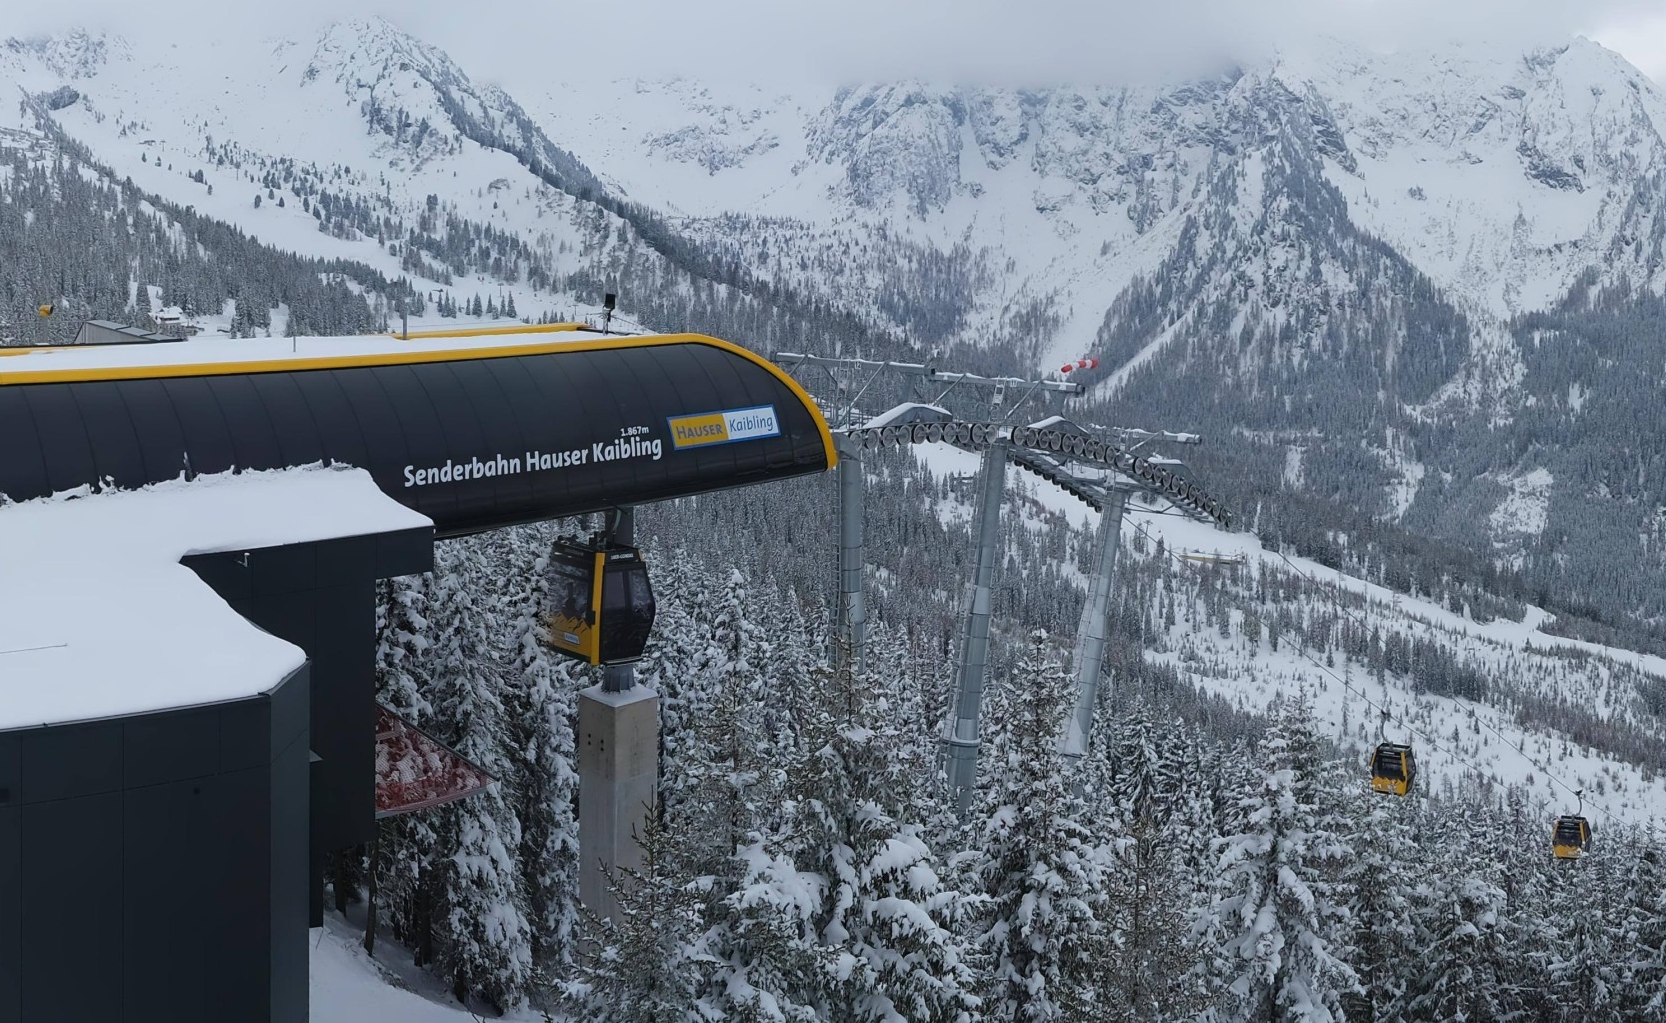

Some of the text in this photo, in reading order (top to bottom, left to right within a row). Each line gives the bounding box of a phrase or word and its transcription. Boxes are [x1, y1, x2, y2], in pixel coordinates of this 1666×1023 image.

[676, 415, 773, 439] HAUSER Kaibling
[404, 436, 662, 487] Senderbahn Hauser Kaibling
